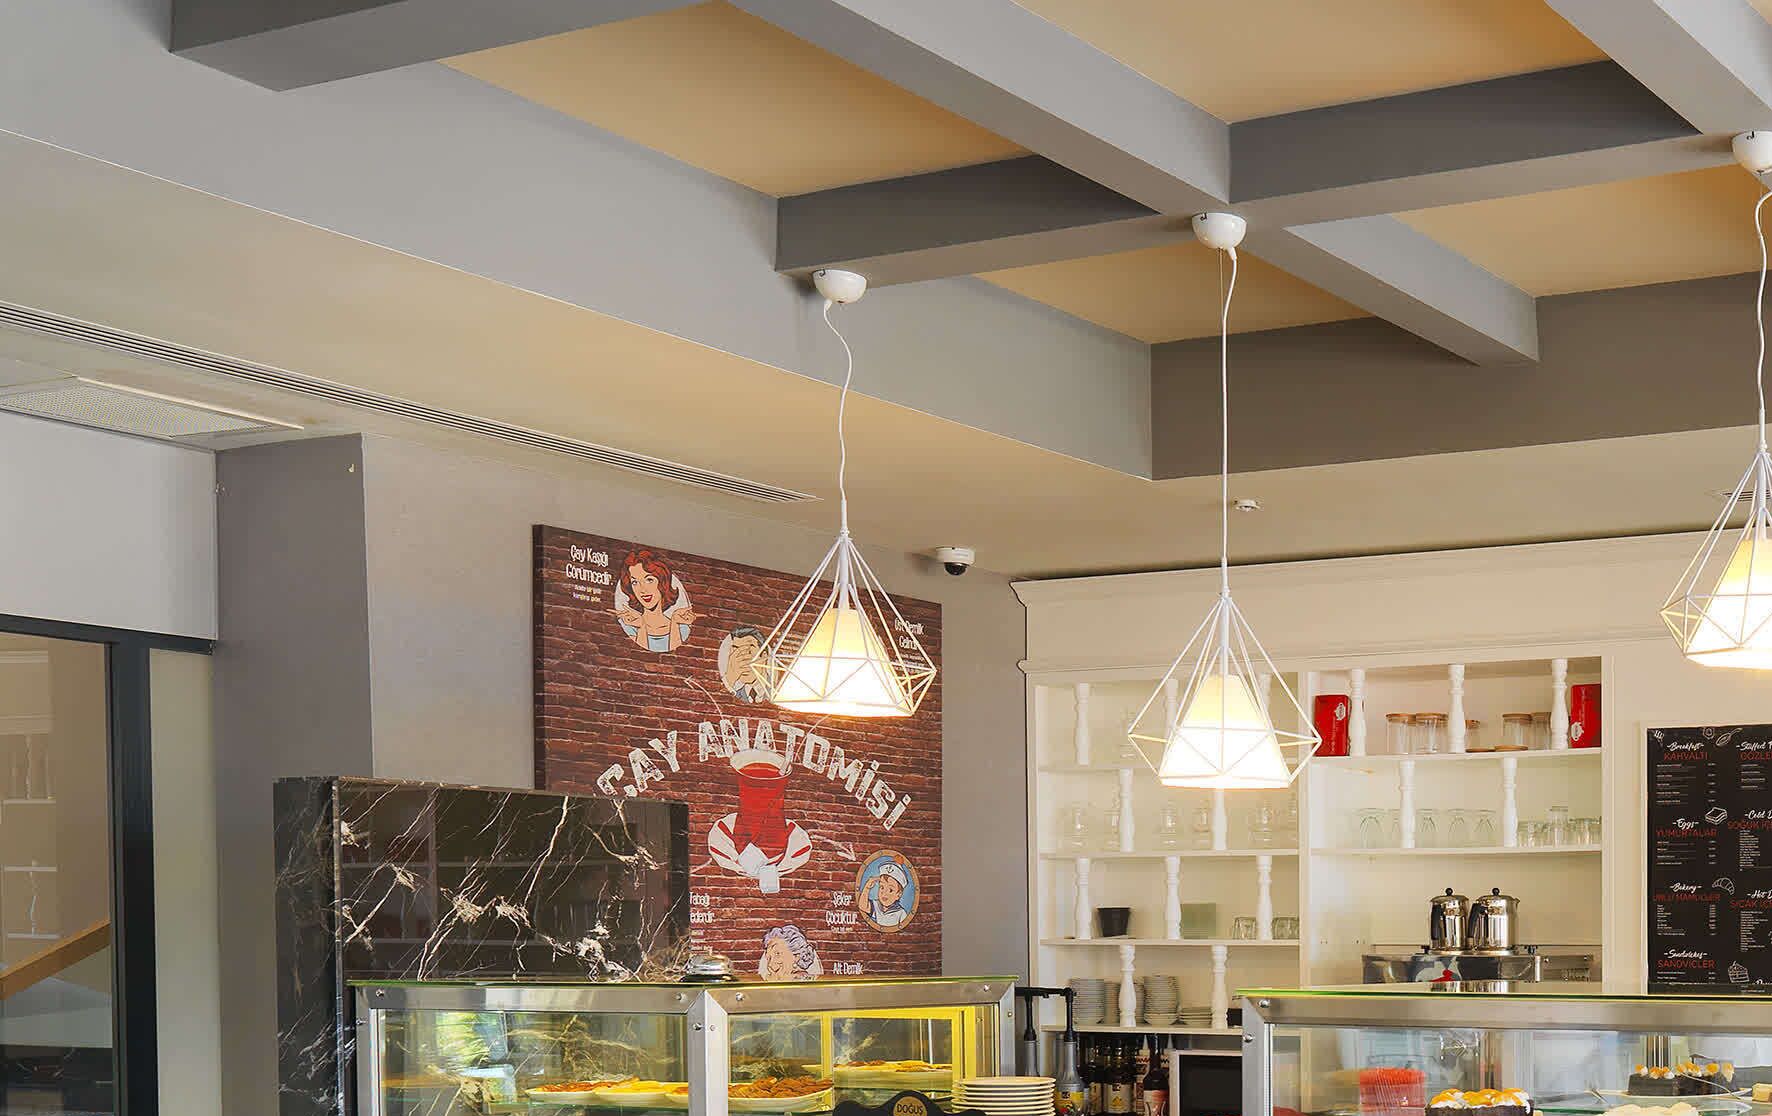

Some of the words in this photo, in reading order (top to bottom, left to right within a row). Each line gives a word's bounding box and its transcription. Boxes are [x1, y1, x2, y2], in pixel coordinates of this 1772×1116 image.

[570, 544, 586, 563] Çay
[595, 730, 678, 798] ÇAY
[698, 718, 912, 831] ANATOMİSİ
[833, 962, 843, 975] Alt
[843, 962, 864, 976] Demlik
[896, 1102, 923, 1115] DOĞUŞ
